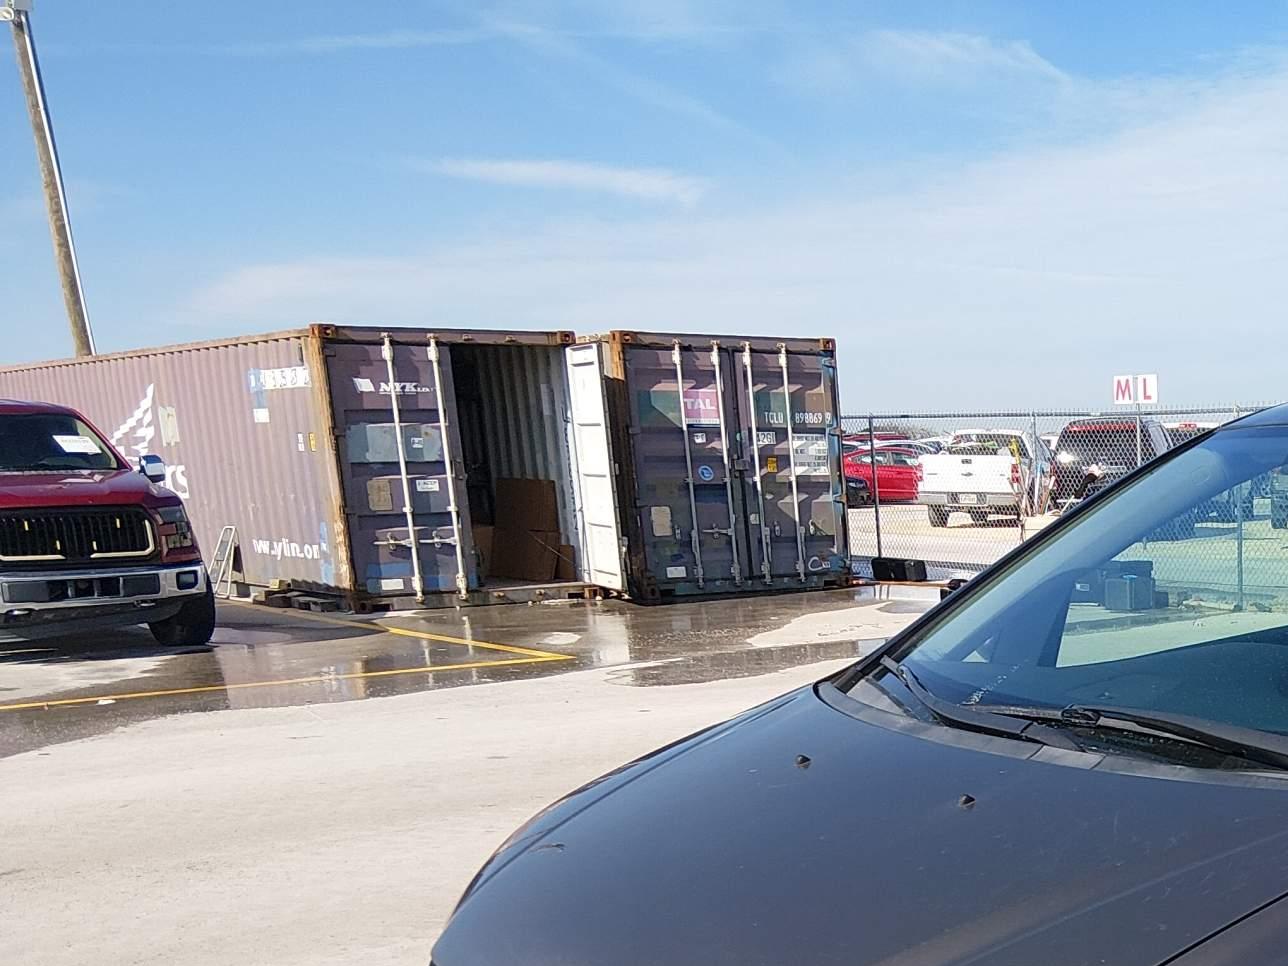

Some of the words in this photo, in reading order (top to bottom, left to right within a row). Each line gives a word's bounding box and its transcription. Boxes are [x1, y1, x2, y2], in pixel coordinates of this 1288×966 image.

[379, 382, 418, 393] NYK
[1116, 378, 1132, 401] M
[1143, 377, 1152, 401] L
[684, 398, 718, 410] TAL
[764, 411, 784, 424] TCLU
